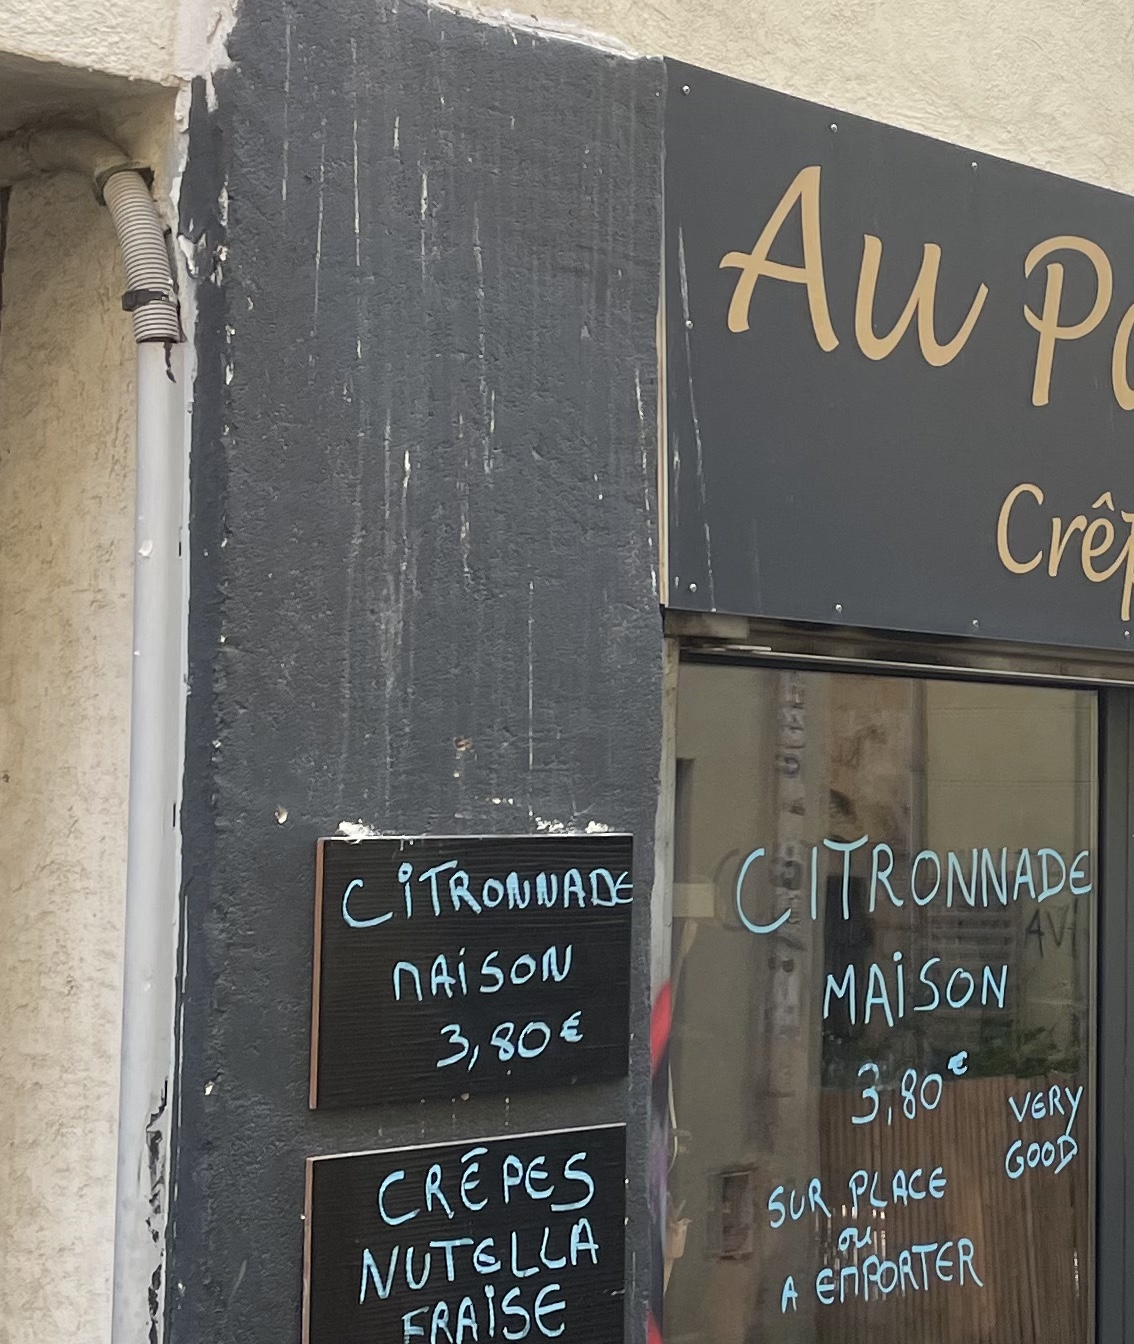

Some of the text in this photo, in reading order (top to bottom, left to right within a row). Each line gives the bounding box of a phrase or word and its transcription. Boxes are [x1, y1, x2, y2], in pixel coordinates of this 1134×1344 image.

[719, 166, 988, 367] Au
[736, 835, 1093, 934] CITRONNADE
[437, 1011, 584, 1072] 3,80€
[851, 1051, 968, 1125] 3,80€
[1009, 1085, 1084, 1137] VERY
[1006, 1135, 1079, 1179] GOOD
[768, 1166, 947, 1228] SUR PLACE
[360, 1218, 599, 1304] NUTELLA
